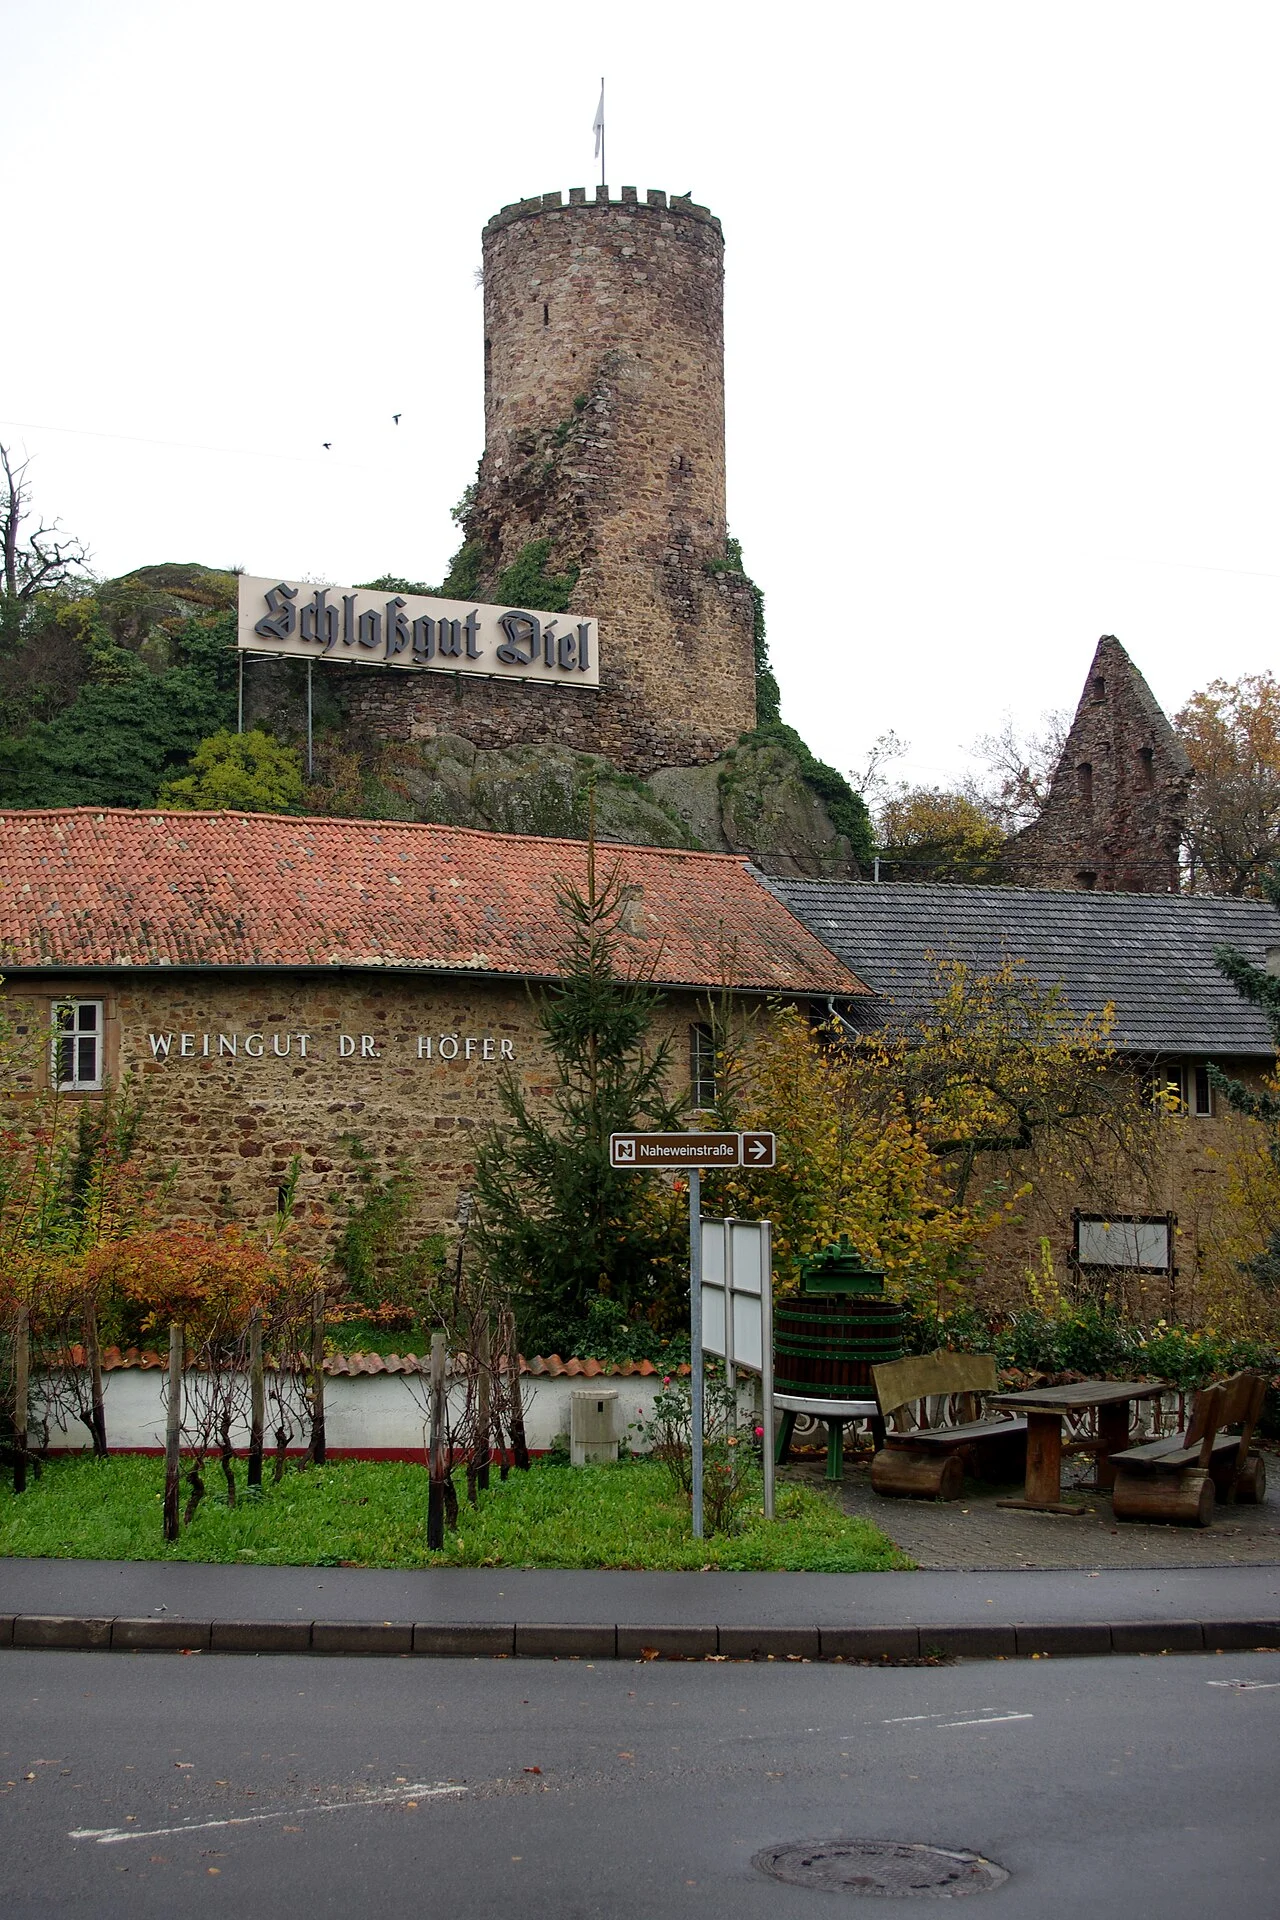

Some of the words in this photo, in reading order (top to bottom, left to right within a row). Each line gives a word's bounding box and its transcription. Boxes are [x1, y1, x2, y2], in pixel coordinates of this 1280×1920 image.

[254, 582, 484, 663] Schloßgut
[496, 610, 592, 672] Diel
[148, 1033, 312, 1058] WEINGUT
[338, 1034, 382, 1058] DR.
[416, 1032, 516, 1061] HÖFER
[640, 1143, 734, 1157] Naheweinstraße
